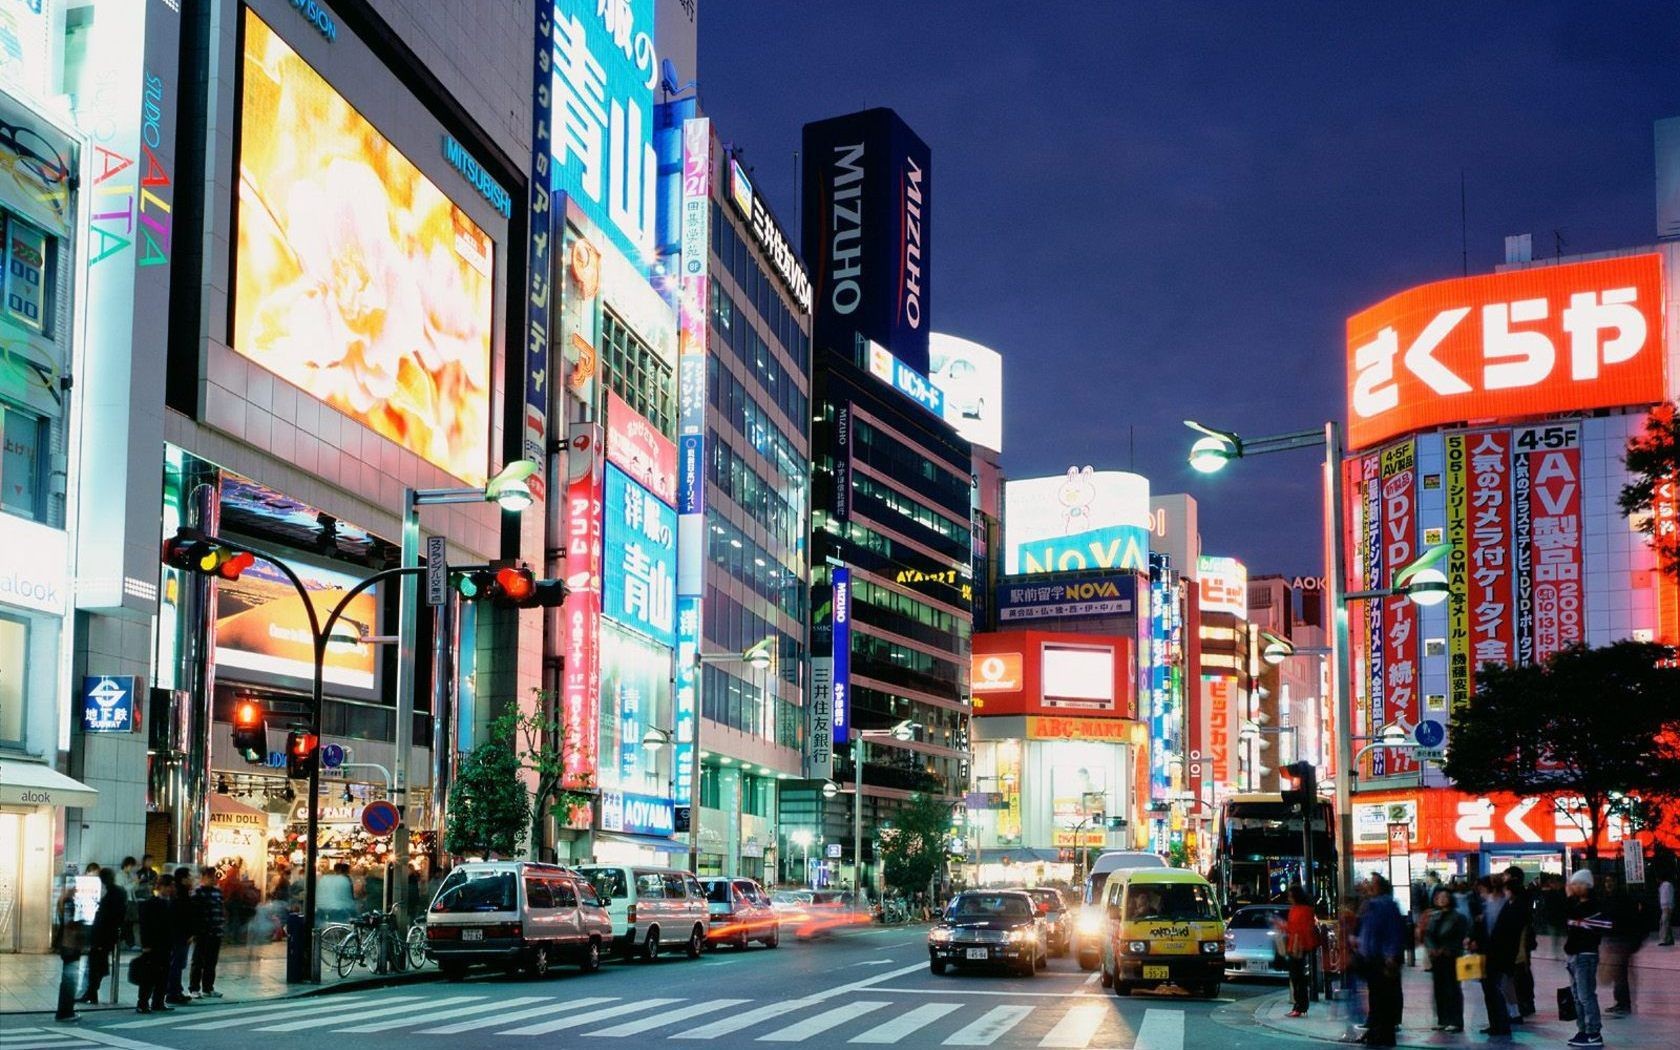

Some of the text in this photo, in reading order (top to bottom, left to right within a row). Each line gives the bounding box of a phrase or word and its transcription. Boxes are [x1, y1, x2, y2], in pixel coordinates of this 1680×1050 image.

[444, 137, 511, 219] MITSUBISHI
[138, 143, 171, 267] ALTA
[832, 141, 865, 315] MIZUHO
[906, 156, 923, 329] MIZUHO
[1353, 286, 1648, 418] さくらや
[898, 364, 941, 409] UCカード
[839, 408, 847, 446] MIZUHO
[1025, 536, 1145, 575] NOVA
[1, 571, 58, 602] alook
[836, 583, 846, 623] MIZUHO
[1065, 582, 1120, 600] NOVA
[85, 707, 128, 721] 地下鉄
[90, 719, 121, 729] SUBWAY
[814, 668, 829, 764] 三井住友銀行
[1034, 716, 1125, 740] ABC-MART
[21, 790, 51, 803] alook
[624, 801, 671, 830] AOYAMA
[236, 814, 260, 825] DOLL
